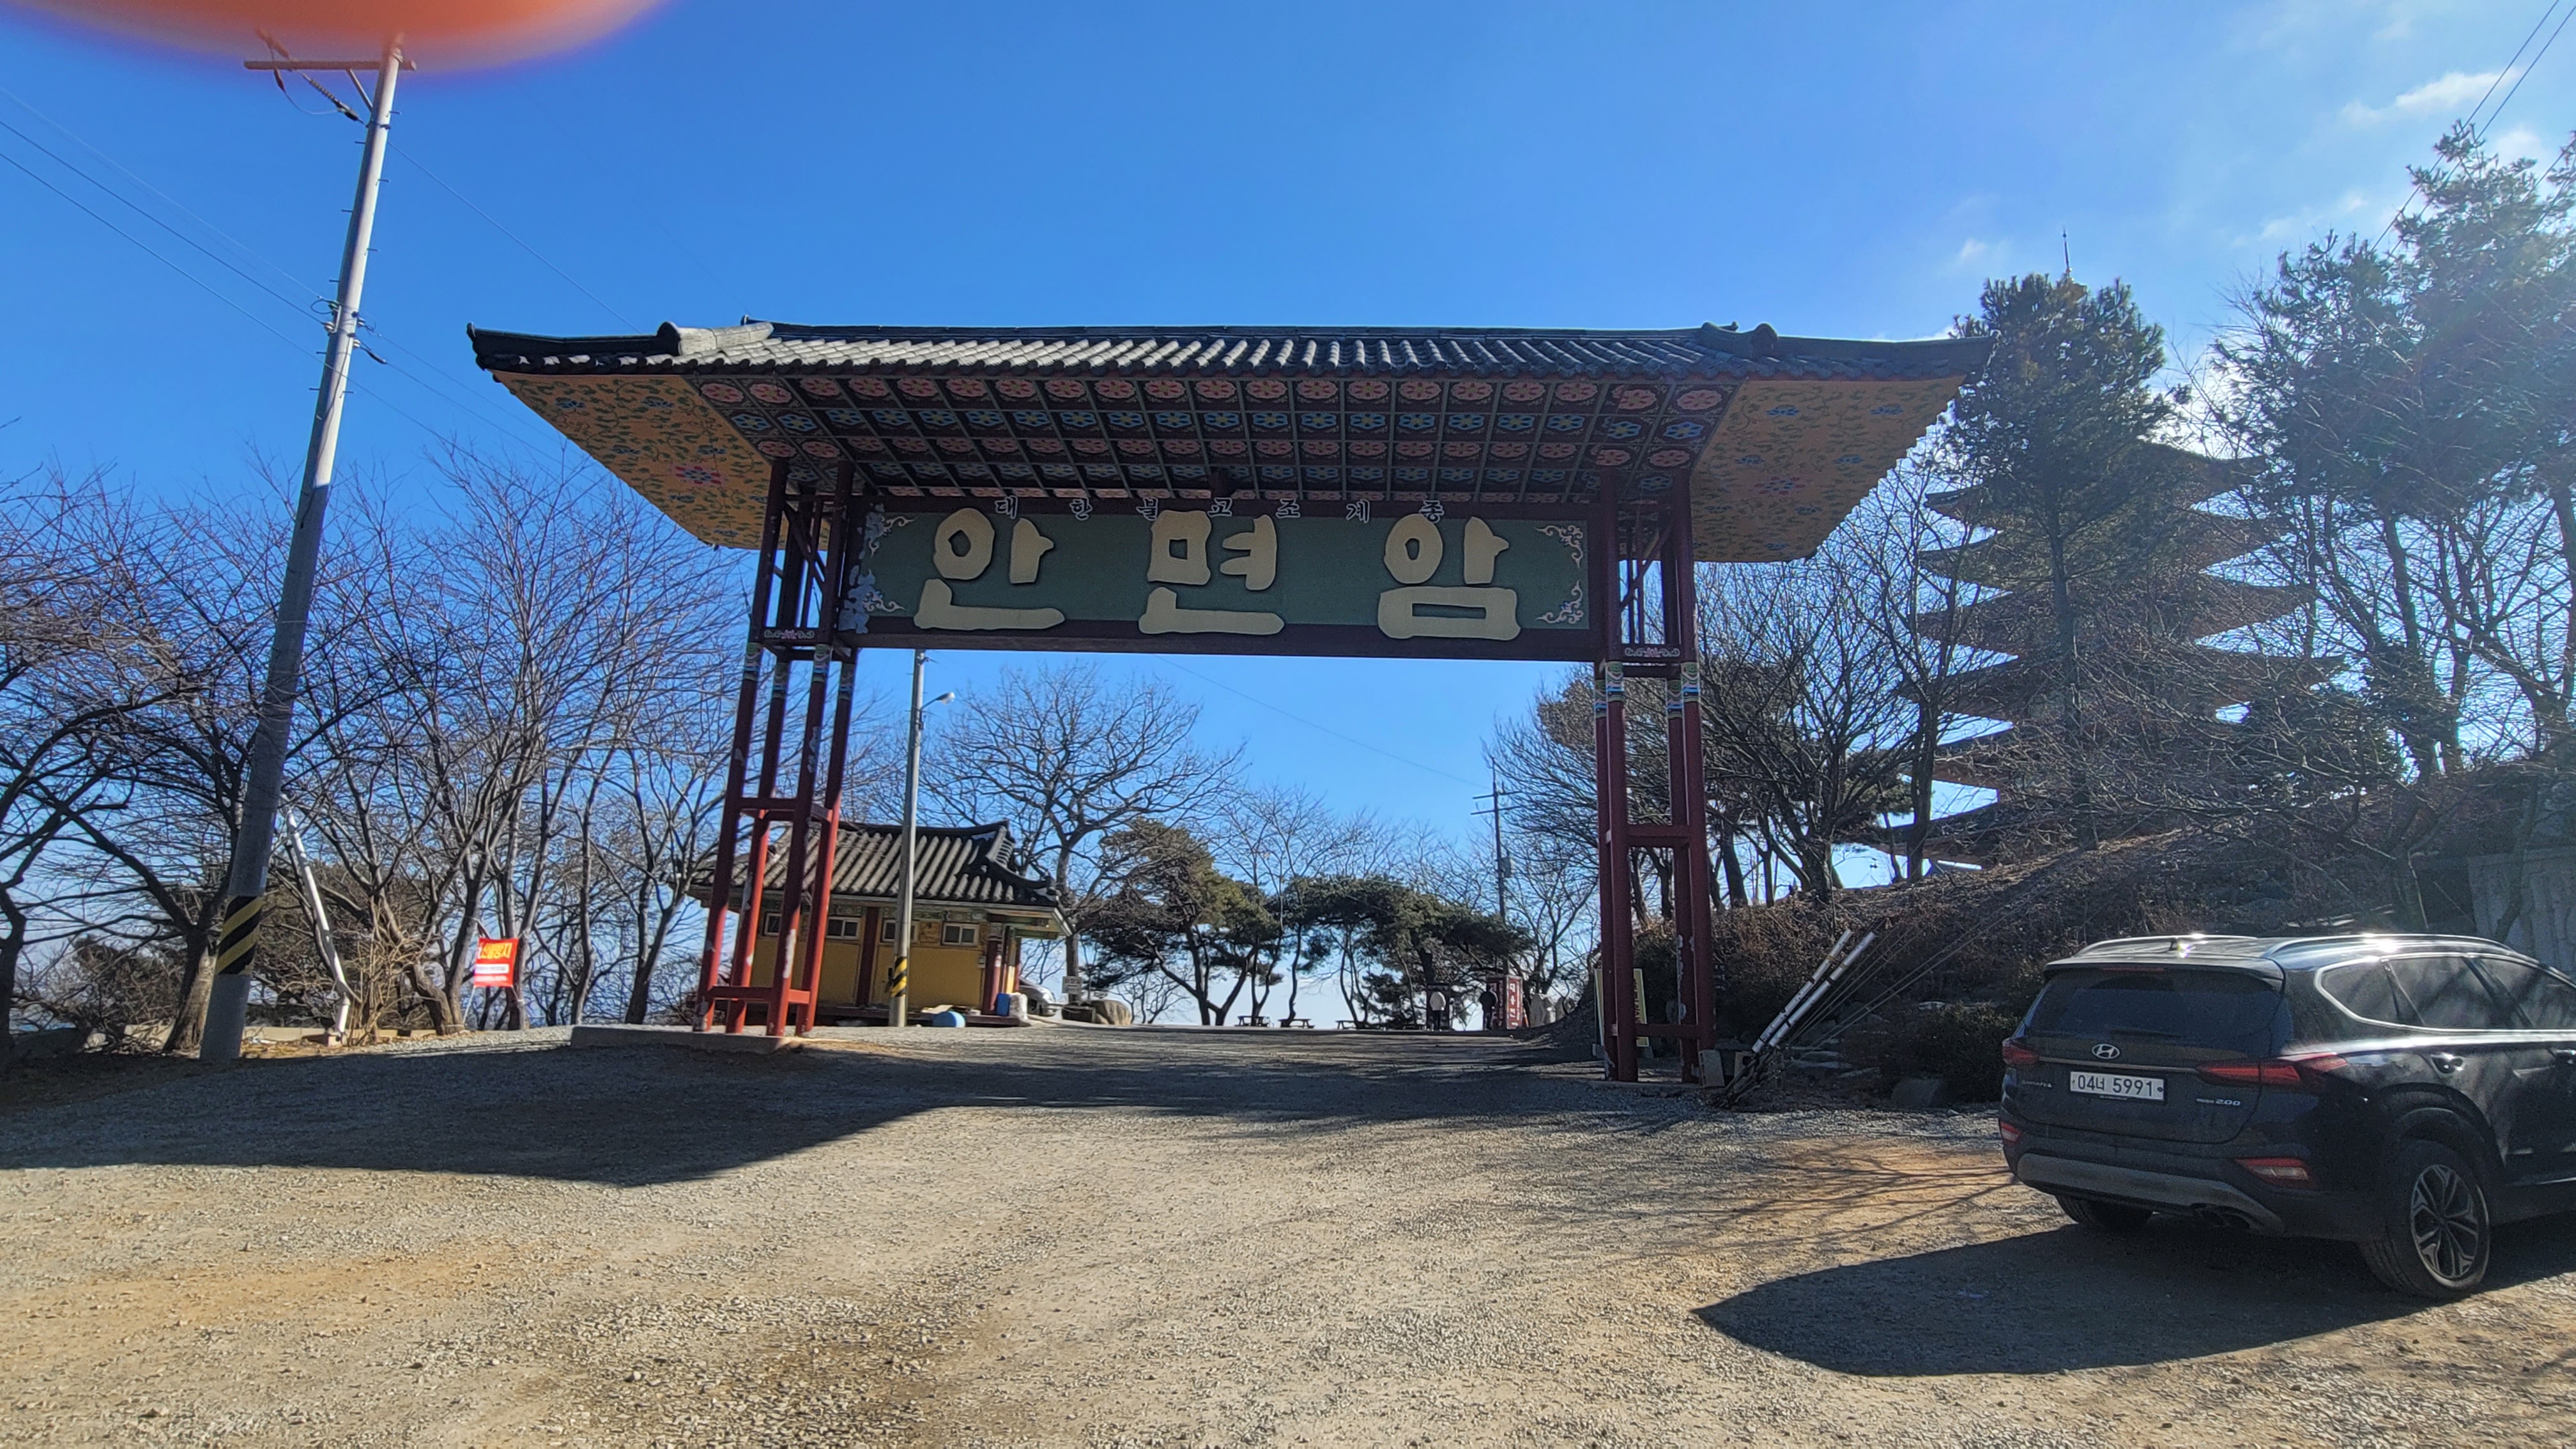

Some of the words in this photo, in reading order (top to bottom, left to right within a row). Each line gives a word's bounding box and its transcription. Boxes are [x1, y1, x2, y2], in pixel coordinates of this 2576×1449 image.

[913, 507, 1522, 641] 안면암
[2078, 1075, 2105, 1091] 04너
[2112, 1077, 2152, 1097] 5991
